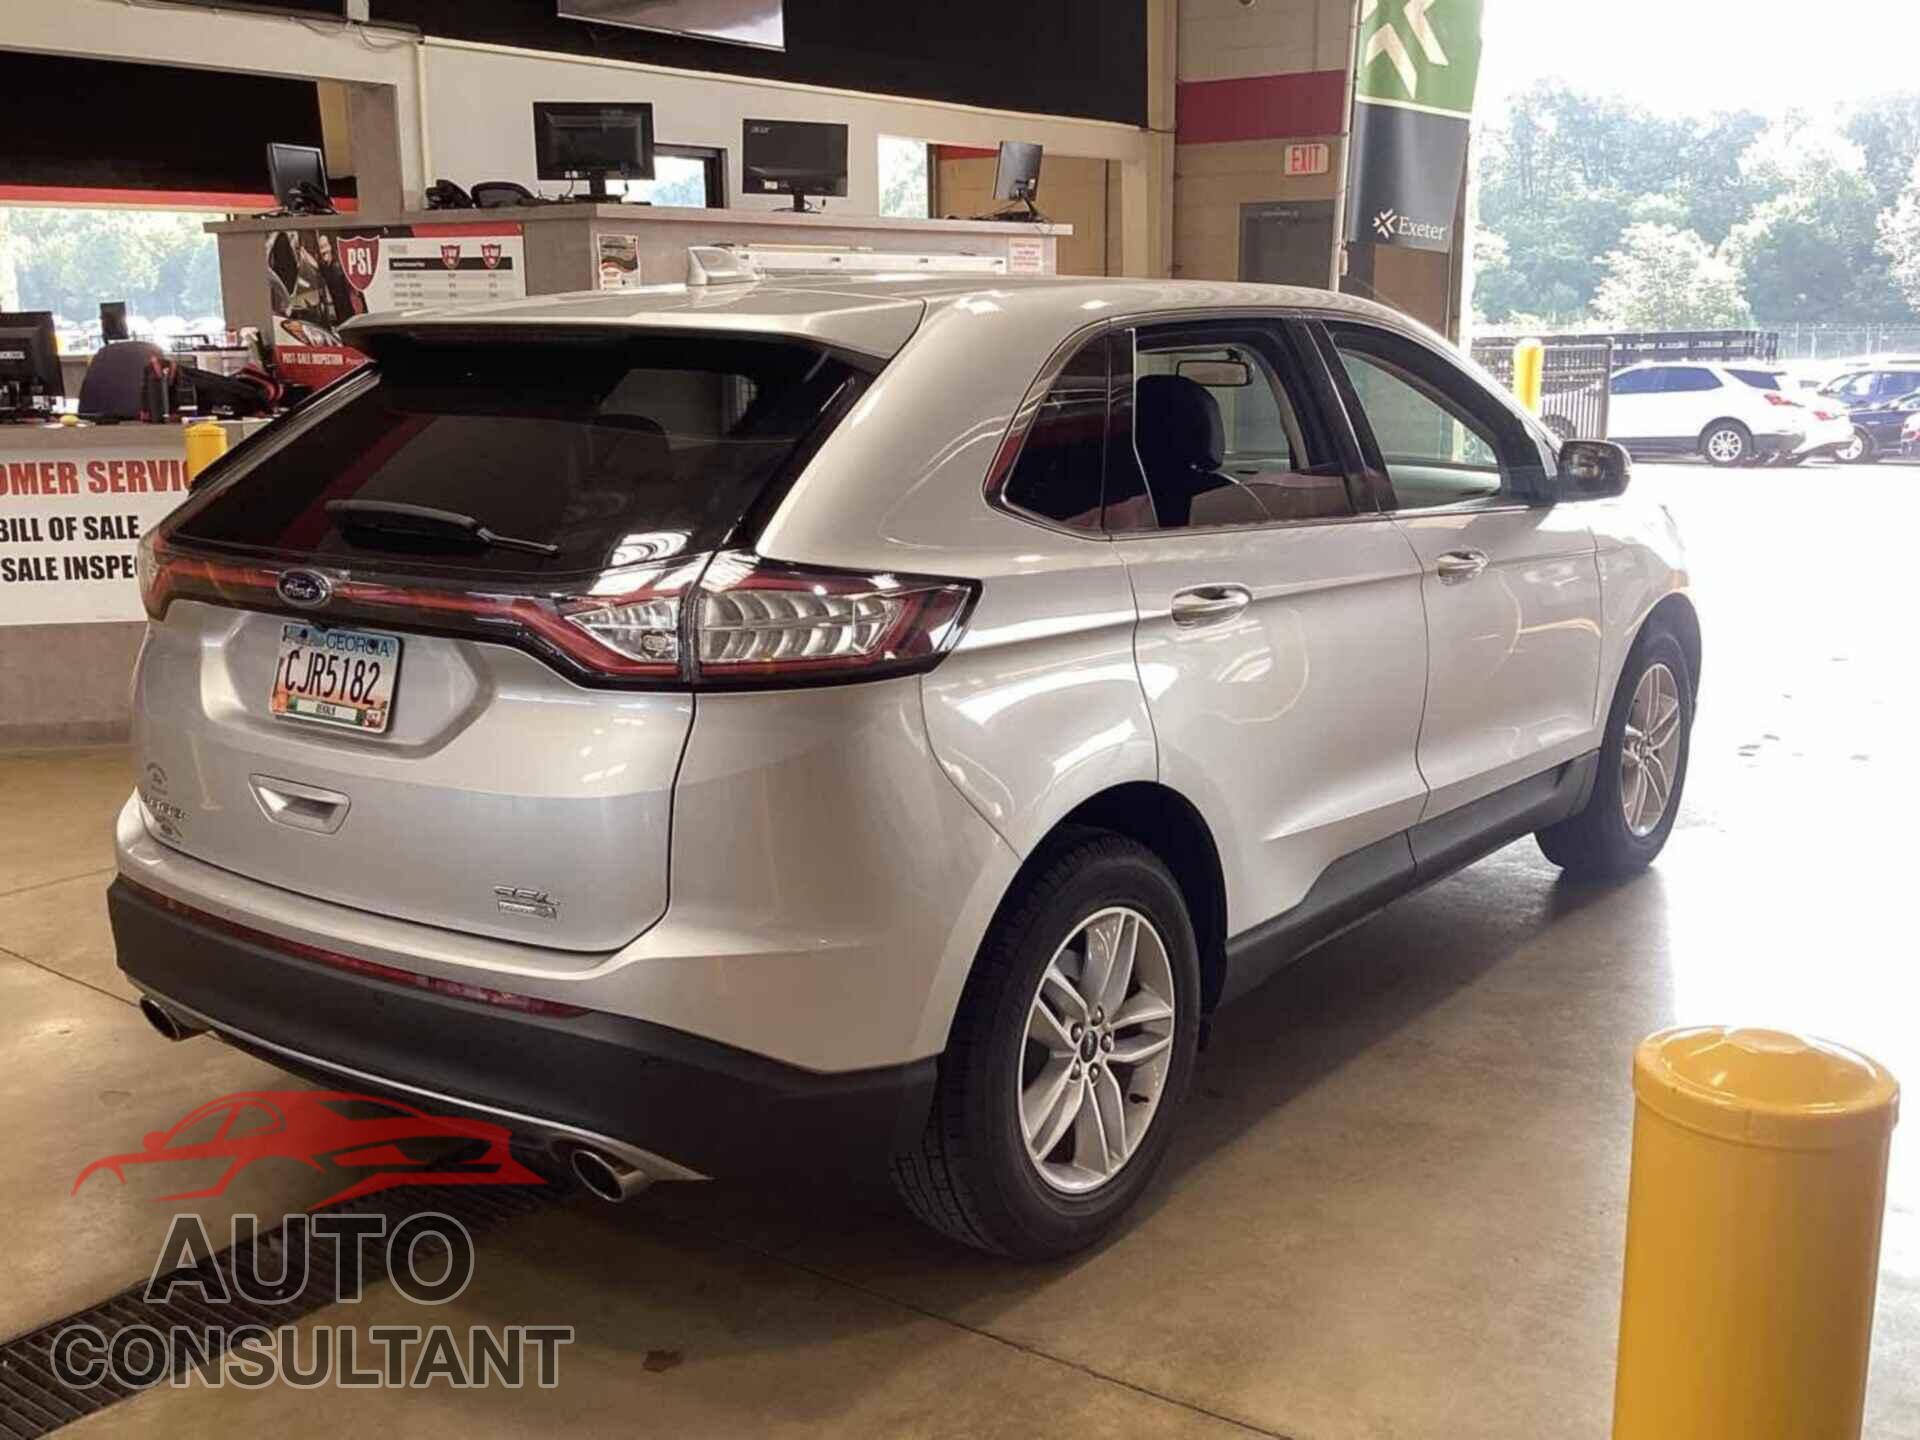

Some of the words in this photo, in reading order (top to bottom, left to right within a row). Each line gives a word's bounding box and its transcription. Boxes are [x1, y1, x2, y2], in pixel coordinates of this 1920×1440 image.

[1291, 146, 1320, 172] EXIT
[1398, 216, 1446, 241] Exeter
[346, 247, 373, 276] PSI
[48, 517, 77, 541] OF
[83, 515, 140, 541] SALE
[1, 557, 58, 582] SALE
[64, 555, 138, 580] INSPE
[325, 633, 390, 657] GEORGIA
[284, 649, 381, 705] CJR5182
